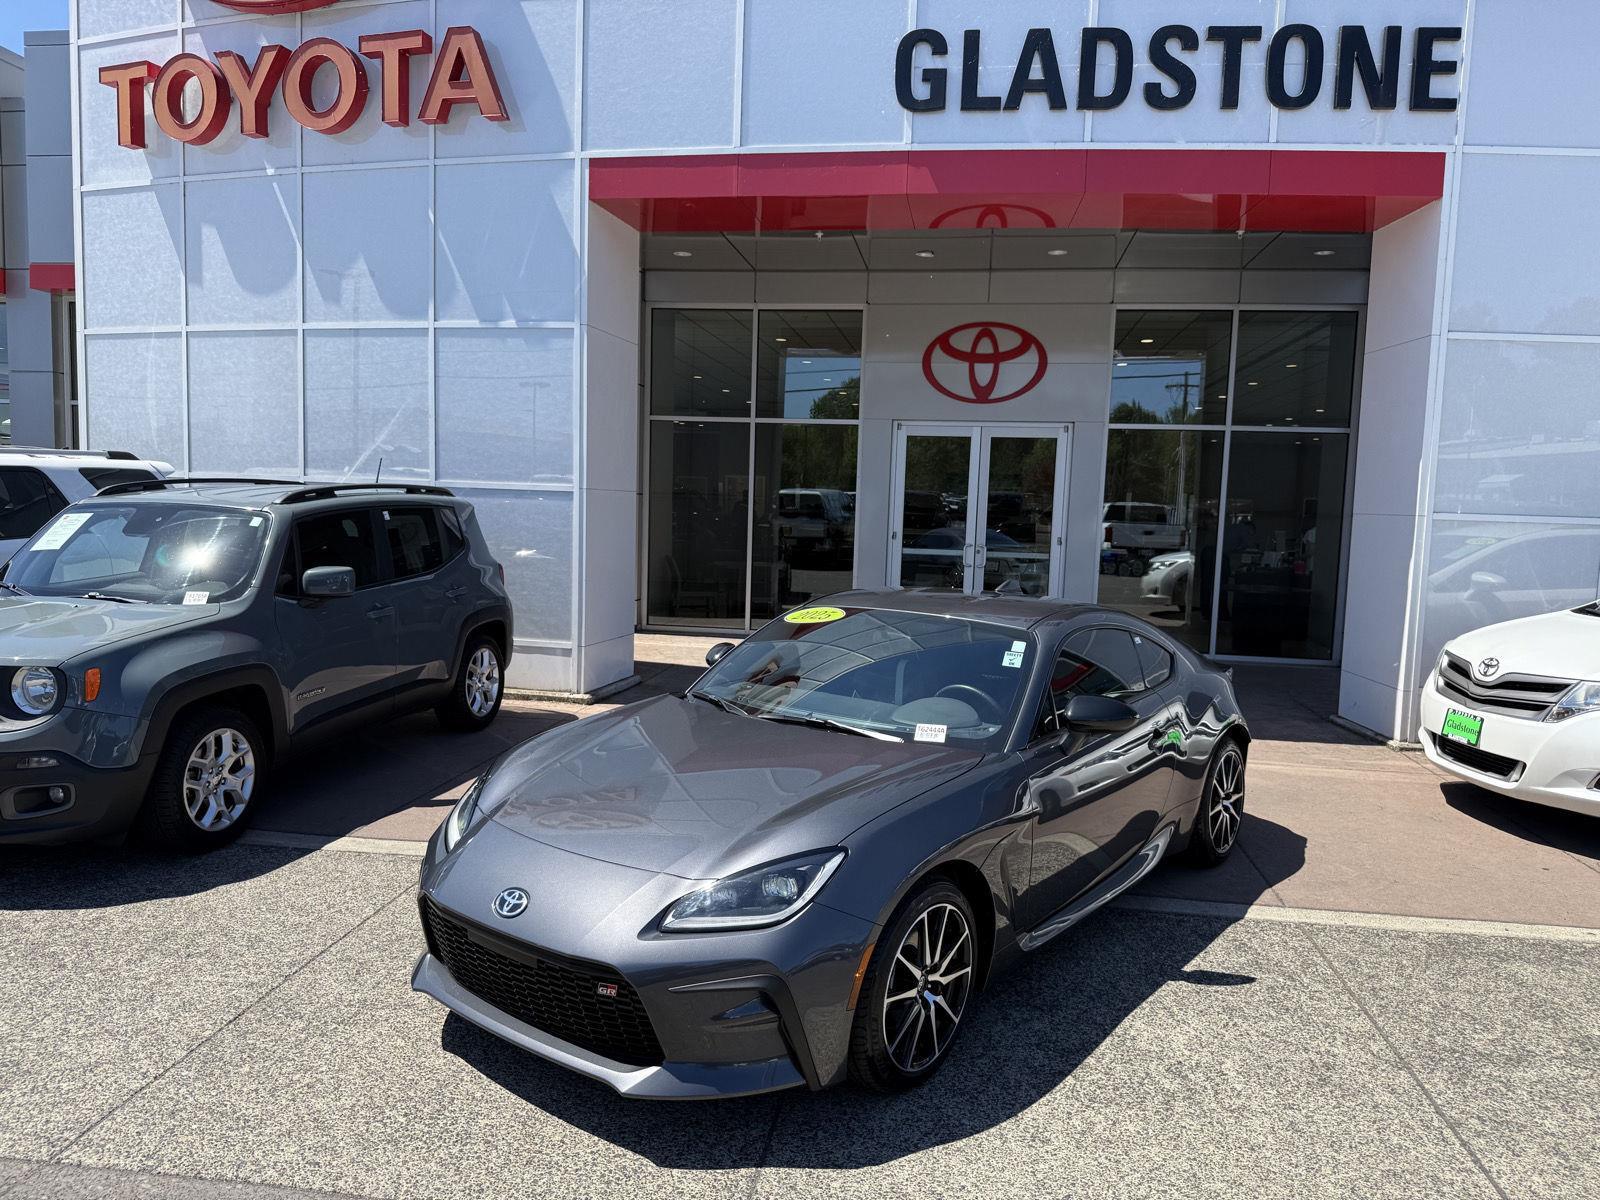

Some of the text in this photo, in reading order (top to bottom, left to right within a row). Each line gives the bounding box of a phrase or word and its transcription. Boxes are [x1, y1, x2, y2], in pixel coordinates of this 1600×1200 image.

[99, 26, 509, 149] TOYOTA
[895, 24, 1462, 111] GLADSTONE
[599, 987, 617, 997] GR
